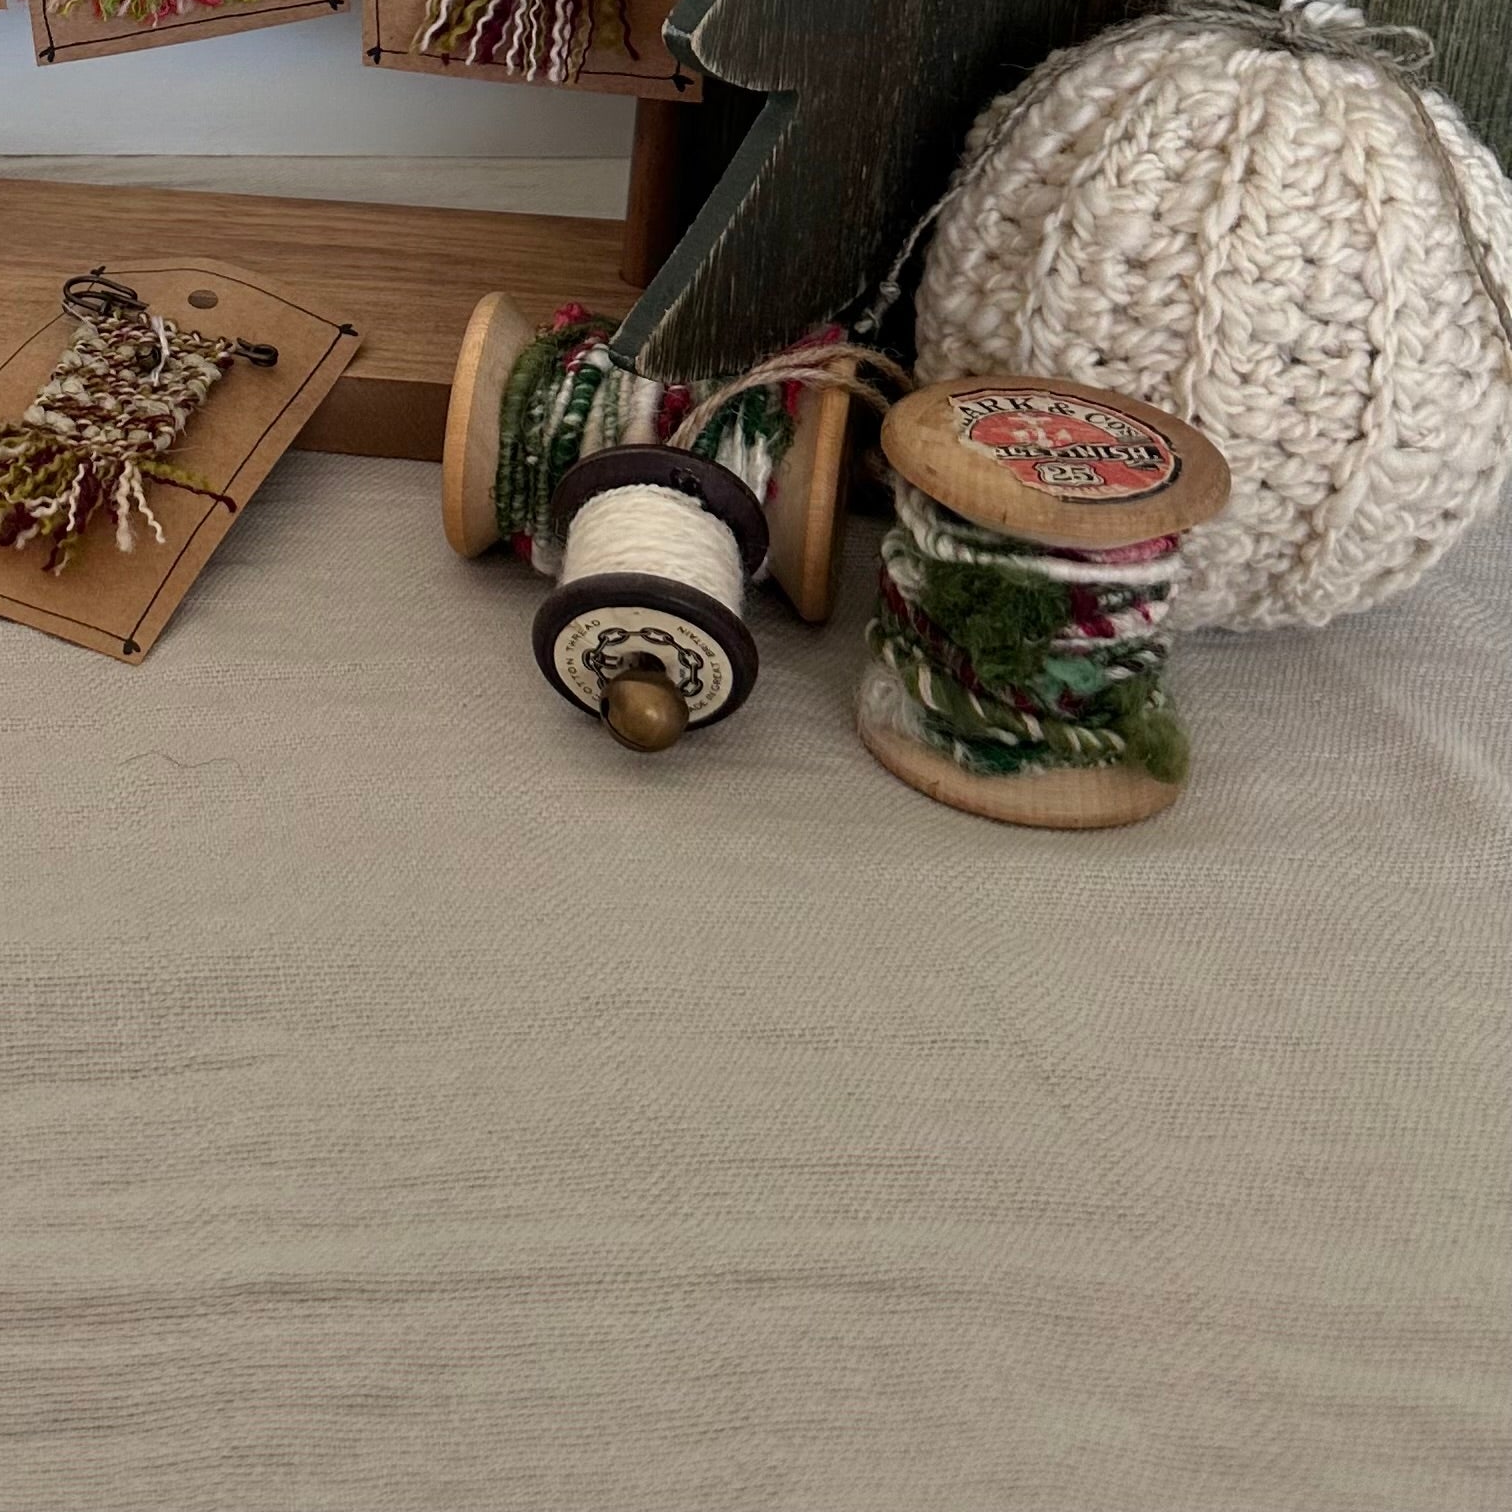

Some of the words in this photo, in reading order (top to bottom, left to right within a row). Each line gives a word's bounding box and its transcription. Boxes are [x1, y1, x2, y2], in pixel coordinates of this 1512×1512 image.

[1048, 402, 1076, 416] &
[1048, 466, 1095, 481] 25
[565, 619, 601, 651] THREAD
[677, 625, 717, 659] BRITAIN
[710, 661, 723, 691] GREAT
